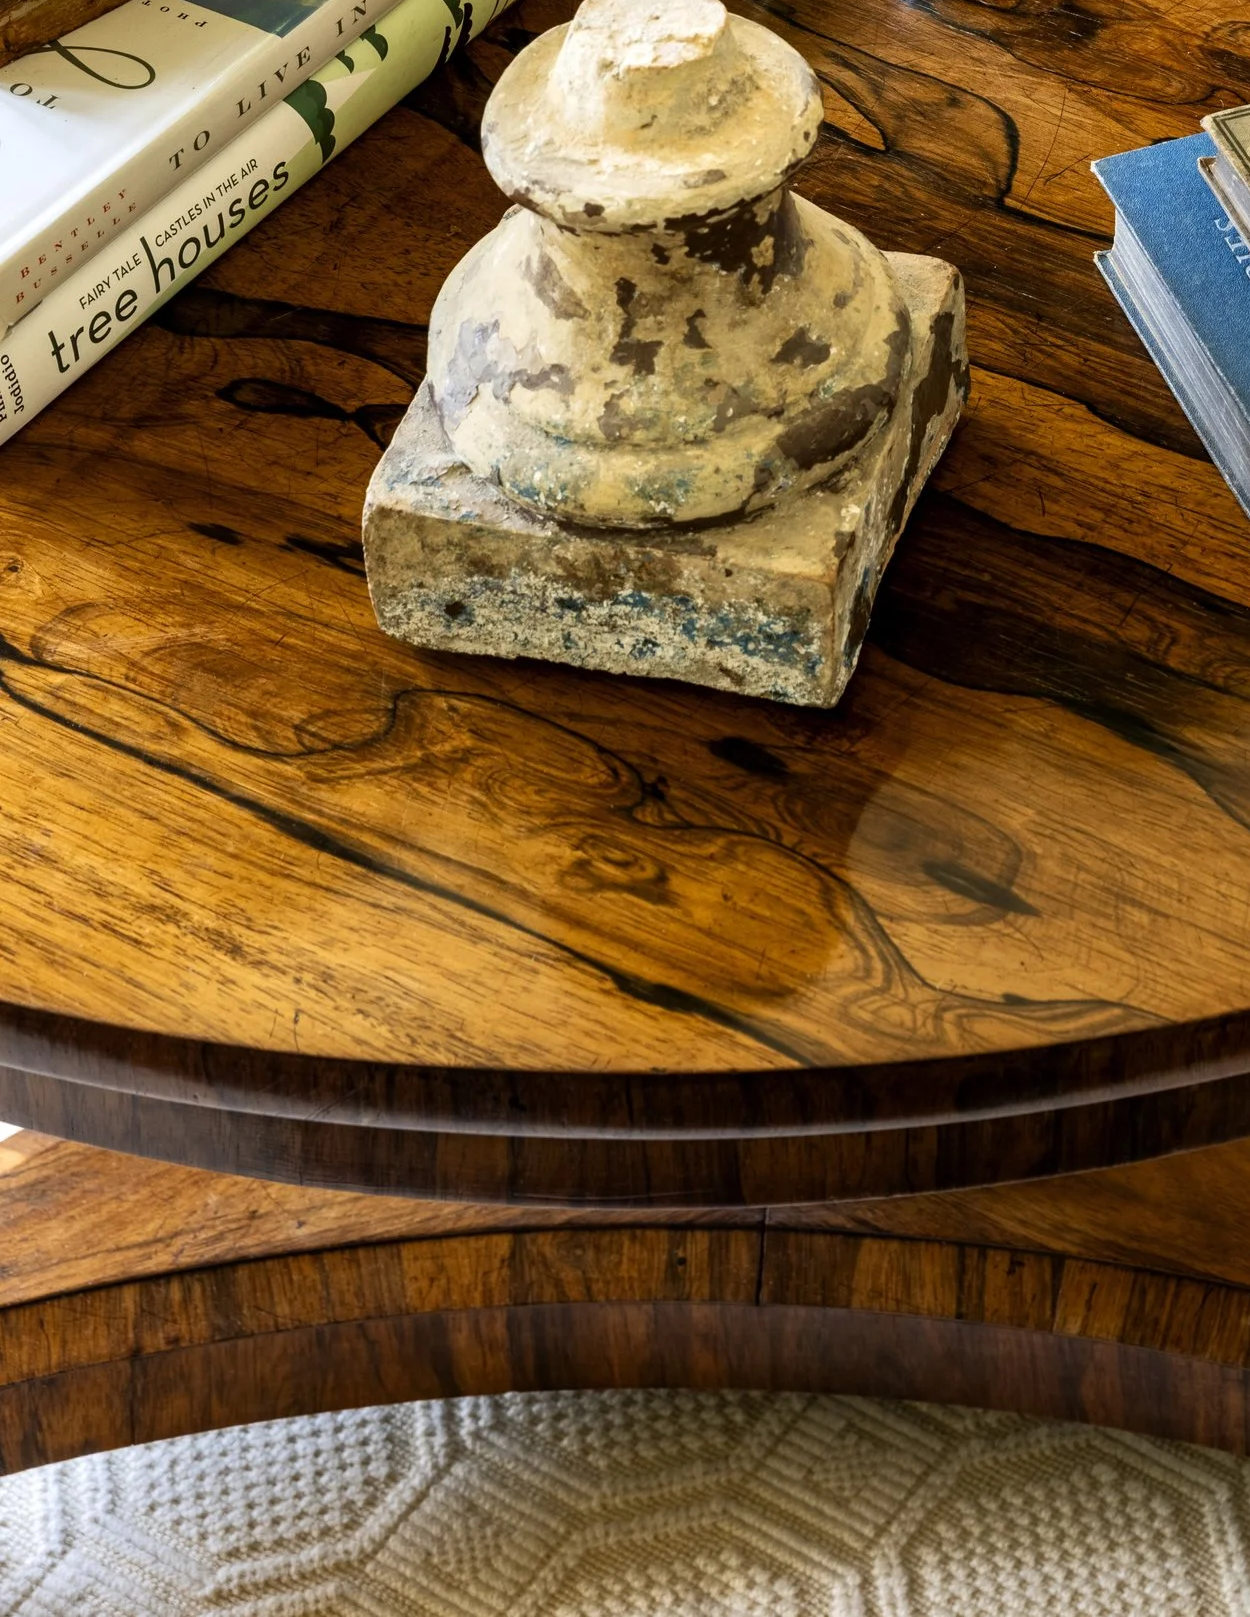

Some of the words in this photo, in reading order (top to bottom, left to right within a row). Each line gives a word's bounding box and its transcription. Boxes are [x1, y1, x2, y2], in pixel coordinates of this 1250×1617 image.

[9, 82, 62, 110] TO
[169, 129, 212, 171] TO
[235, 45, 312, 119] LIVE
[15, 202, 137, 304] BUSSELLE
[20, 189, 128, 279] BENTLEY
[48, 289, 138, 374] tree
[140, 161, 290, 294] houses
[79, 278, 112, 310] FAIRY
[112, 252, 143, 283] TALE
[155, 204, 203, 248] CASTLES
[202, 192, 216, 210] IN
[215, 175, 240, 200] THE
[240, 158, 259, 181] AIR
[0, 354, 25, 415] Jodidio
